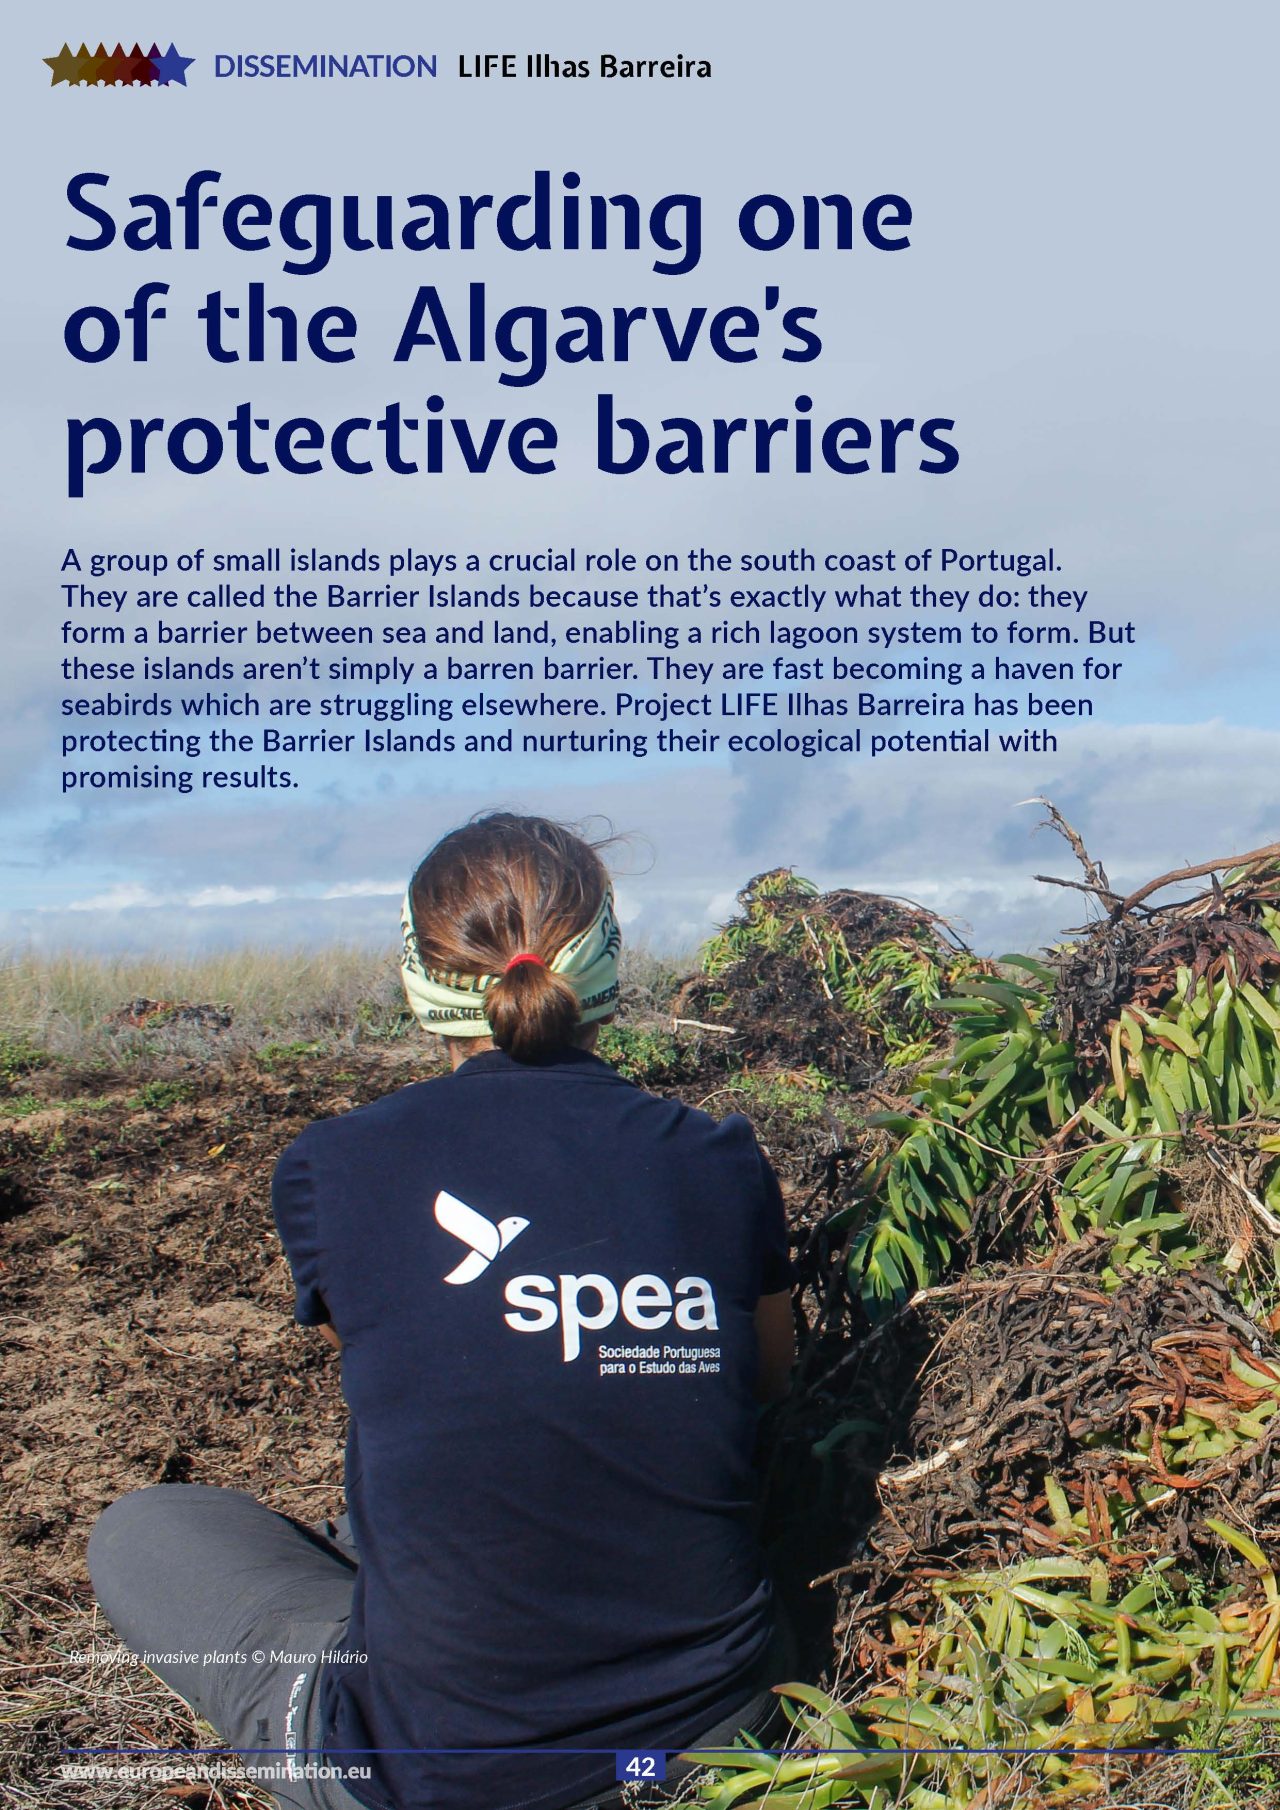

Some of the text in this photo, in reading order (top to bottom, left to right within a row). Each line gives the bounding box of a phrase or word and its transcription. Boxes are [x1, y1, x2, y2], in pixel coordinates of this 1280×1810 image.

[504, 1273, 720, 1363] spea
[598, 1345, 721, 1361] Sociedade Portuguesa
[600, 1361, 720, 1376] para o Estudo das Aves
